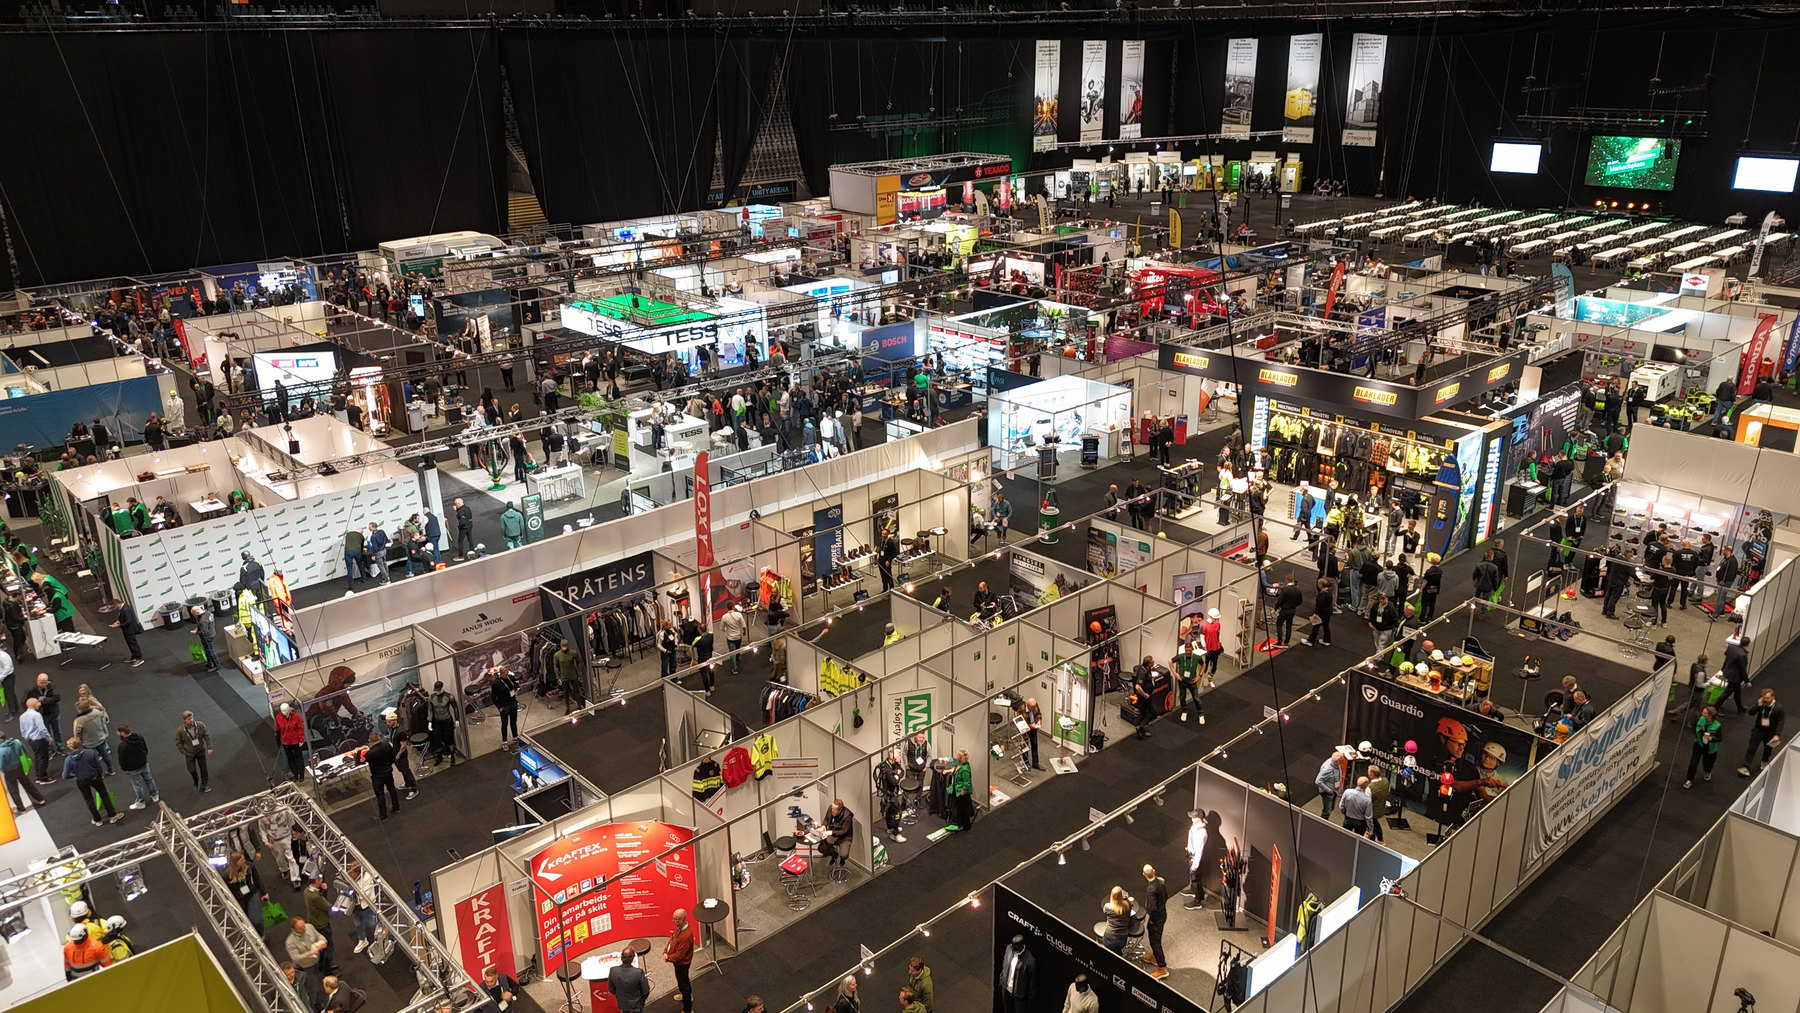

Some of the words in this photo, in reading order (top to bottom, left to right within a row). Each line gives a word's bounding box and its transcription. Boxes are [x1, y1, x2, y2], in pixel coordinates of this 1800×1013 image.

[983, 164, 1010, 176] TEXACO
[751, 188, 769, 197] UNITY
[769, 186, 790, 195] ARENA
[587, 317, 622, 339] TESS
[665, 323, 718, 346] TESS
[881, 335, 907, 348] BOSCH
[1743, 328, 1768, 387] HONDA
[678, 427, 703, 439] TESS
[1344, 418, 1360, 427] PROFIL
[695, 473, 709, 553] LOXY
[1732, 530, 1747, 540] ON
[1734, 521, 1765, 537] WALK
[830, 543, 838, 571] HEROES
[461, 622, 484, 635] JANUS
[483, 616, 504, 627] WOOL
[894, 698, 902, 706] The
[1380, 694, 1424, 719] Guardio
[892, 707, 902, 736] Safety
[547, 842, 602, 870] KRAFTEX
[563, 859, 572, 867] nr
[580, 852, 591, 861] på
[591, 847, 609, 856] skilt
[543, 916, 558, 930] Din
[561, 893, 612, 918] amarbeids-
[575, 910, 586, 921] på
[587, 902, 608, 915] skilt
[1007, 910, 1035, 932] CRAFT
[1045, 932, 1073, 955] CLIQUE
